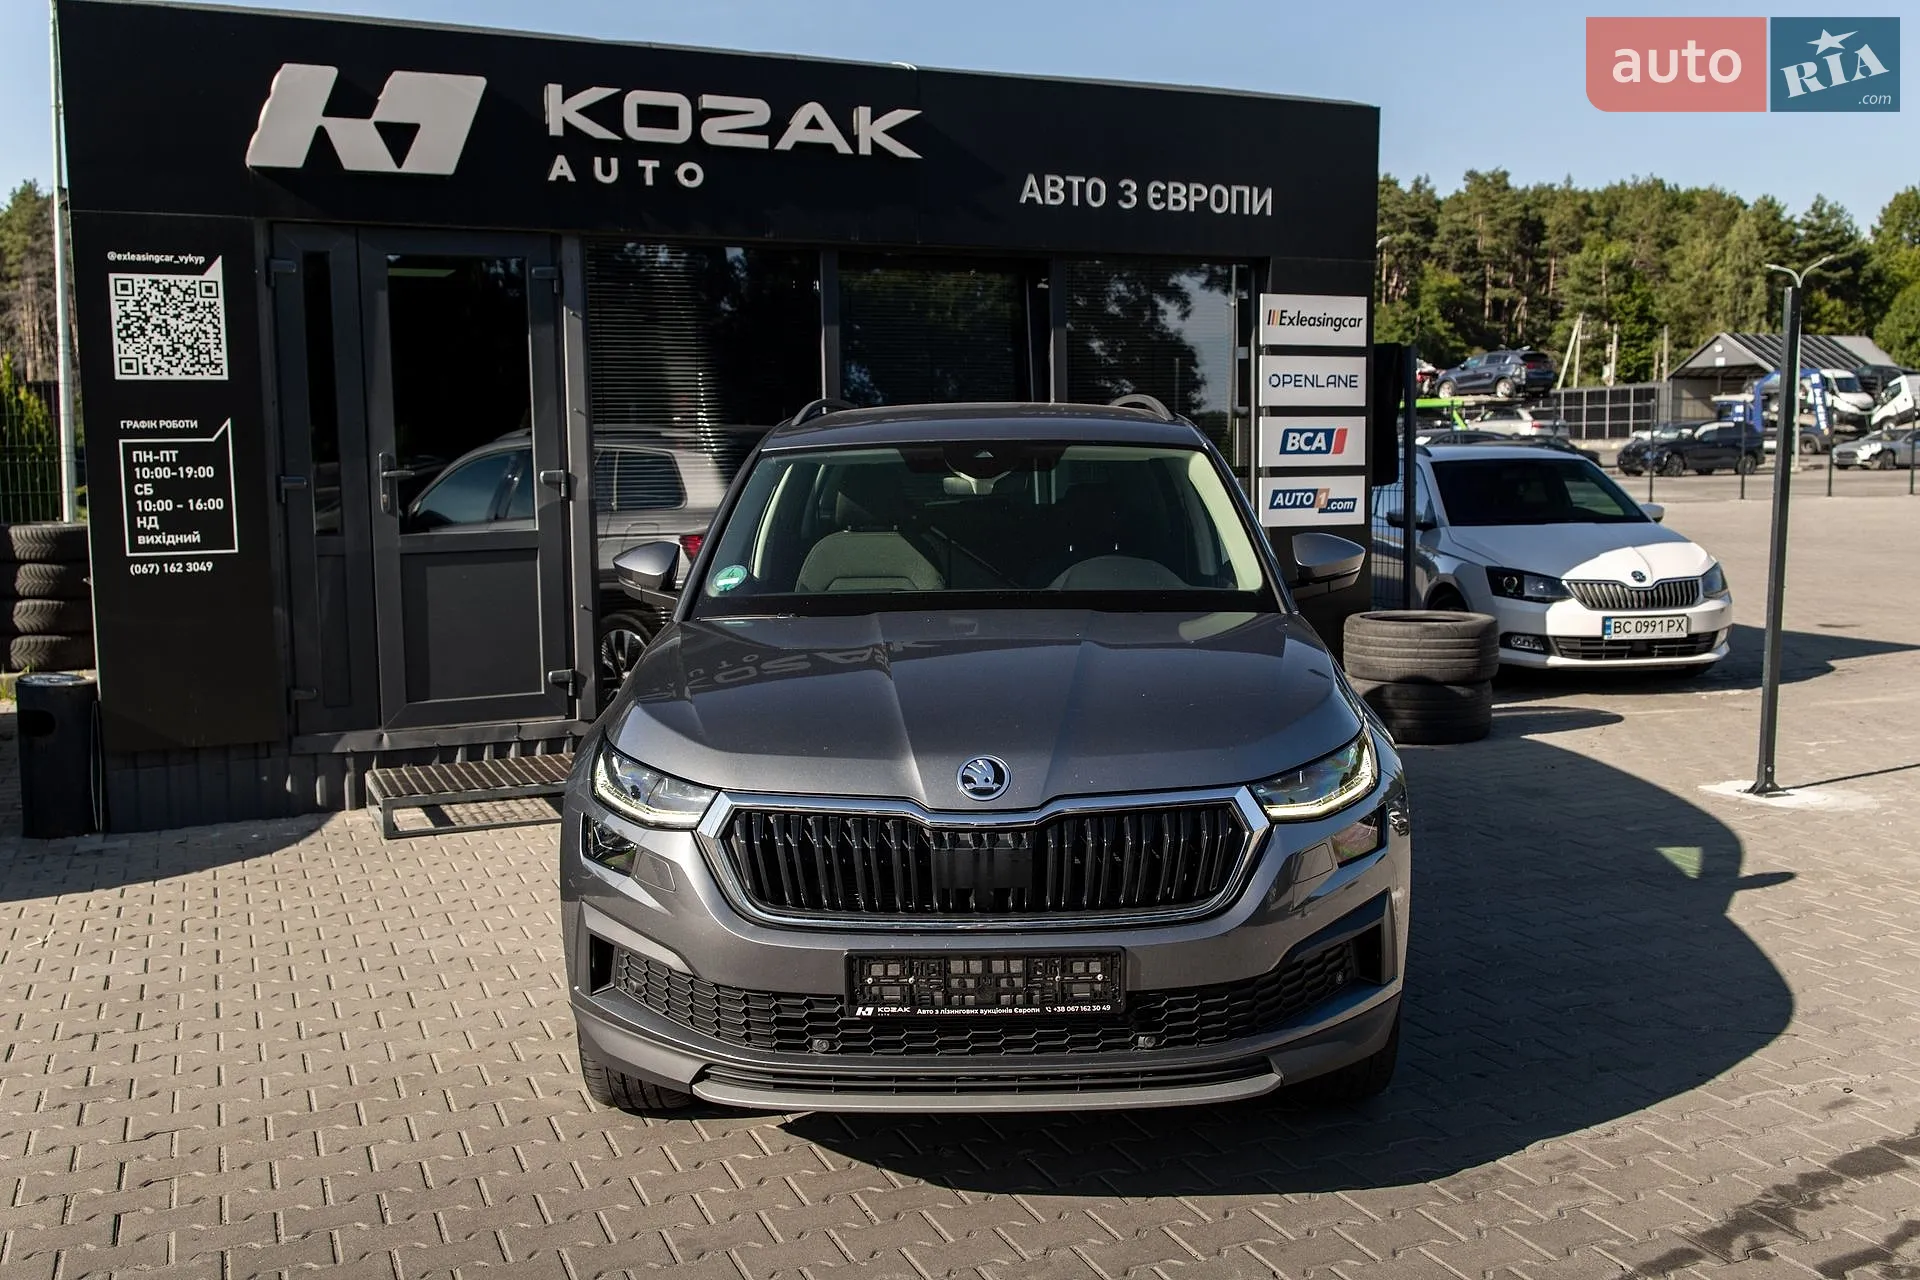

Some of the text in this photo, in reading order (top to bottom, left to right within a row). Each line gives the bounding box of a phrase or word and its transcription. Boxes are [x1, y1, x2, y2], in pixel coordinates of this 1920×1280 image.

[545, 83, 922, 160] KOZAK
[548, 154, 703, 188] AUTO
[1019, 173, 1273, 216] АВТО З ЄВРОПИ
[107, 251, 206, 265] @exleasingcar_vykyp
[1278, 309, 1364, 332] Exleasingcar
[1268, 373, 1359, 389] OPENLANE
[120, 419, 198, 430] ГРАФІК РОБОТИ
[1286, 432, 1327, 451] BCA
[132, 450, 179, 463] ПН-ПТ
[134, 465, 215, 479] 10:00-19:00
[134, 483, 154, 496] СБ
[136, 499, 174, 513] 10:00
[187, 498, 224, 511] 16:00
[136, 515, 160, 530] НД
[137, 530, 201, 546] вихідний
[129, 561, 213, 576] (067) 162 3049
[1613, 618, 1685, 634] BC 0991 PX
[940, 1007, 979, 1016] лізингових
[980, 1006, 1013, 1016] аукціонів
[1013, 1007, 1041, 1016] Європи
[1053, 1005, 1066, 1013] +38
[1092, 1004, 1101, 1012] 30
